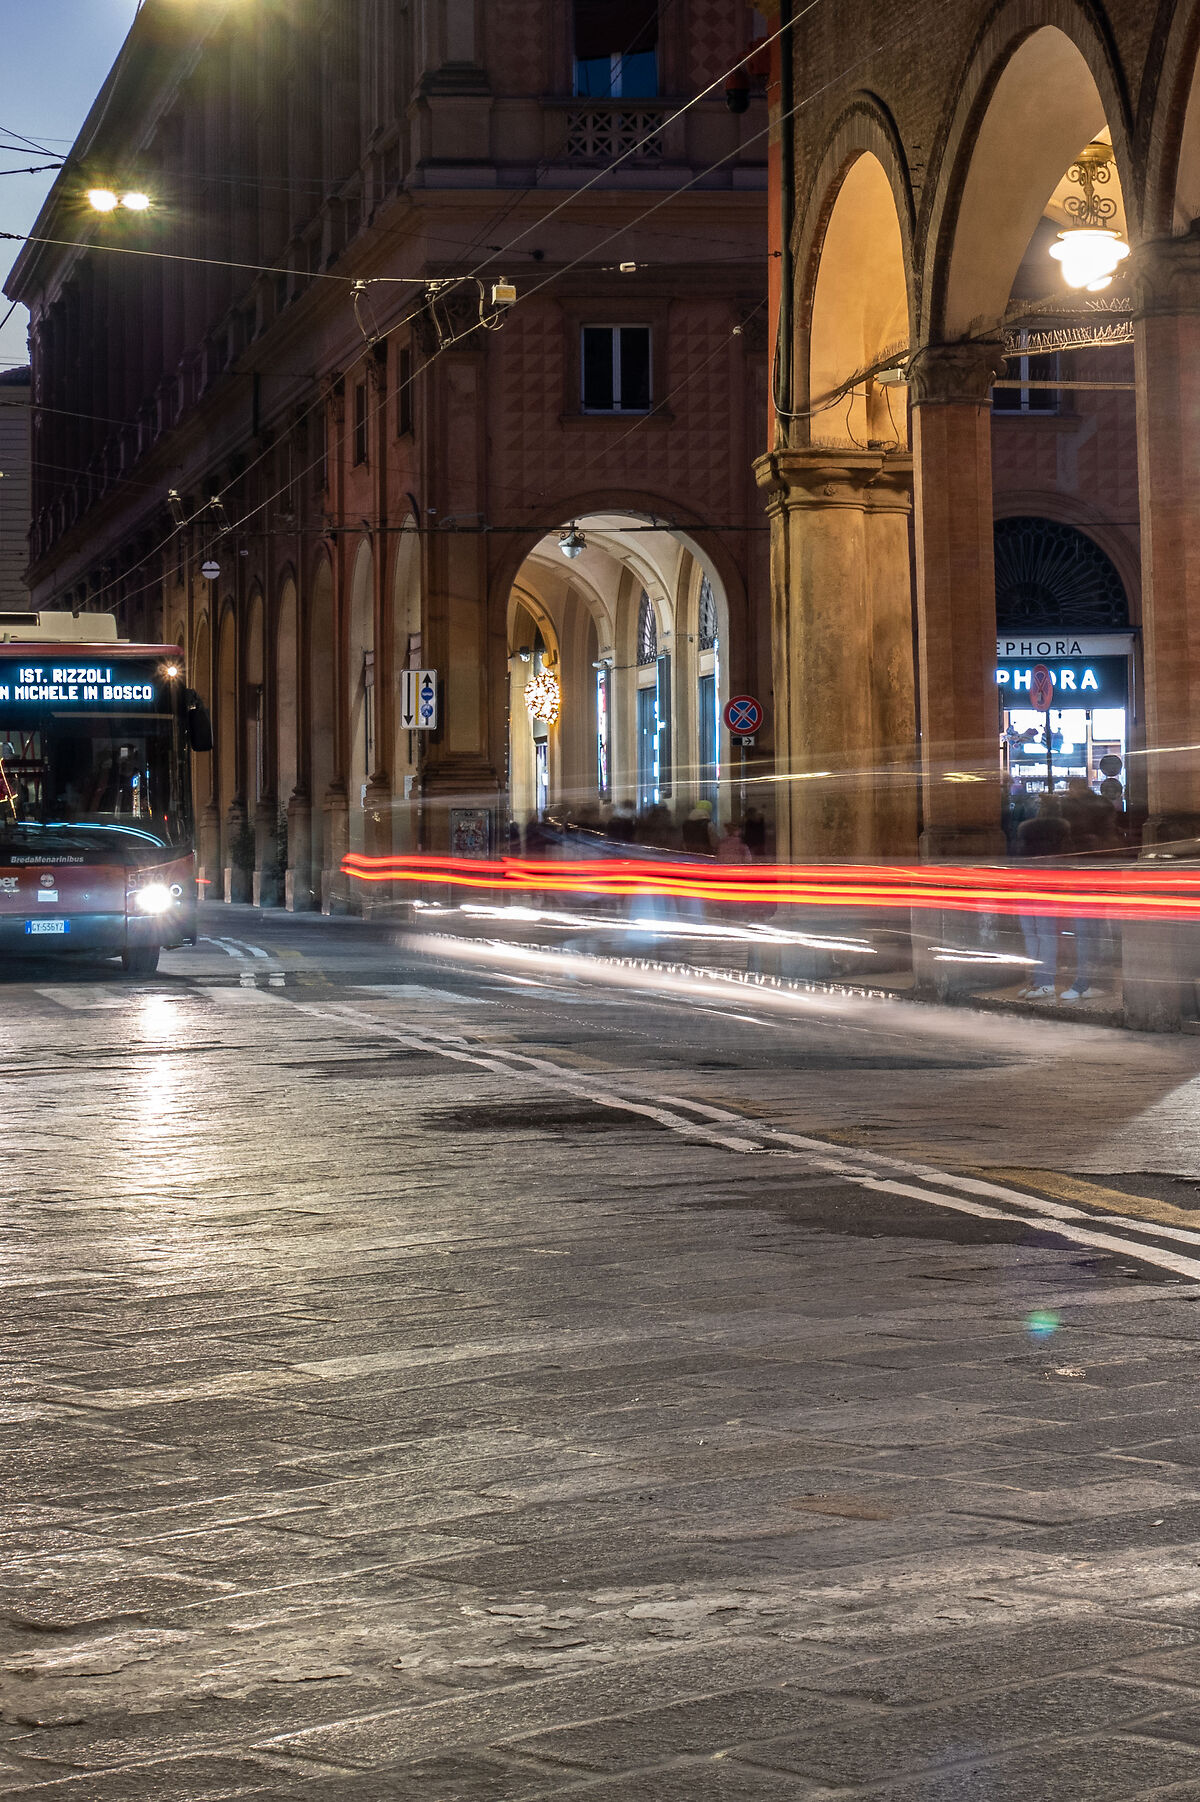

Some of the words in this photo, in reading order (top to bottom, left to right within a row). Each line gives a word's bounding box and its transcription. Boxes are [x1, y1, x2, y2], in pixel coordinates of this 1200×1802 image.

[19, 668, 48, 683] IST.
[52, 668, 111, 683] RIZZOLI
[996, 669, 1098, 690] PHRA
[14, 685, 78, 700] MICHELE
[83, 685, 98, 700] IN
[103, 685, 152, 700] BOSCO
[10, 856, 84, 864] BredaMenarinibus
